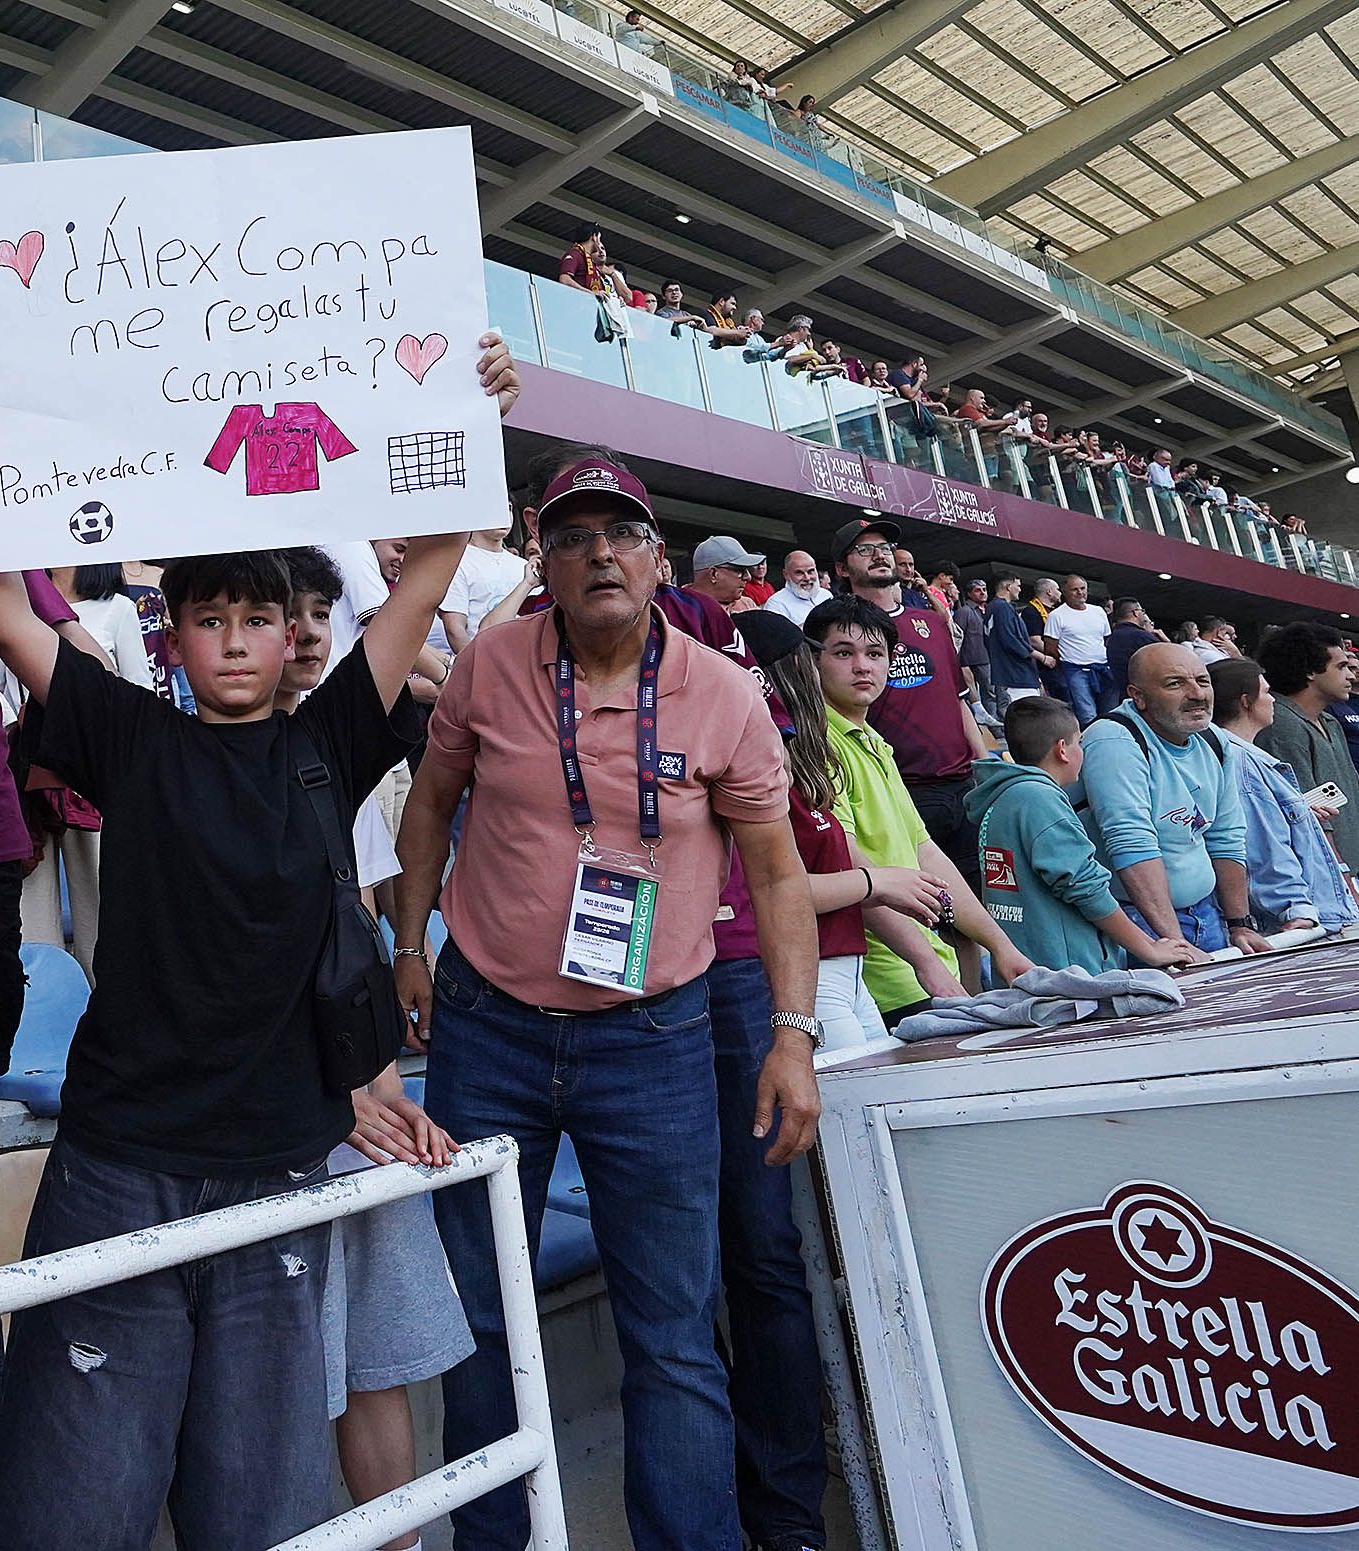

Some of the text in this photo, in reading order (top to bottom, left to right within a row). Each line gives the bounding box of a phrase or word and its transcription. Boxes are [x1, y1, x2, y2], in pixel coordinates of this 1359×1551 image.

[70, 273, 397, 355] me regalas tu
[266, 441, 300, 469] 22
[830, 456, 863, 479] XUNTA
[833, 476, 888, 502] DE GALICIA
[952, 487, 979, 506] XUNTA
[954, 504, 998, 528] DE GALICIA
[888, 660, 927, 678] Galicia
[629, 883, 652, 986] ORGANIZACIÓN
[1052, 1267, 1332, 1377] Estrella
[1072, 1338, 1337, 1452] Galicia
